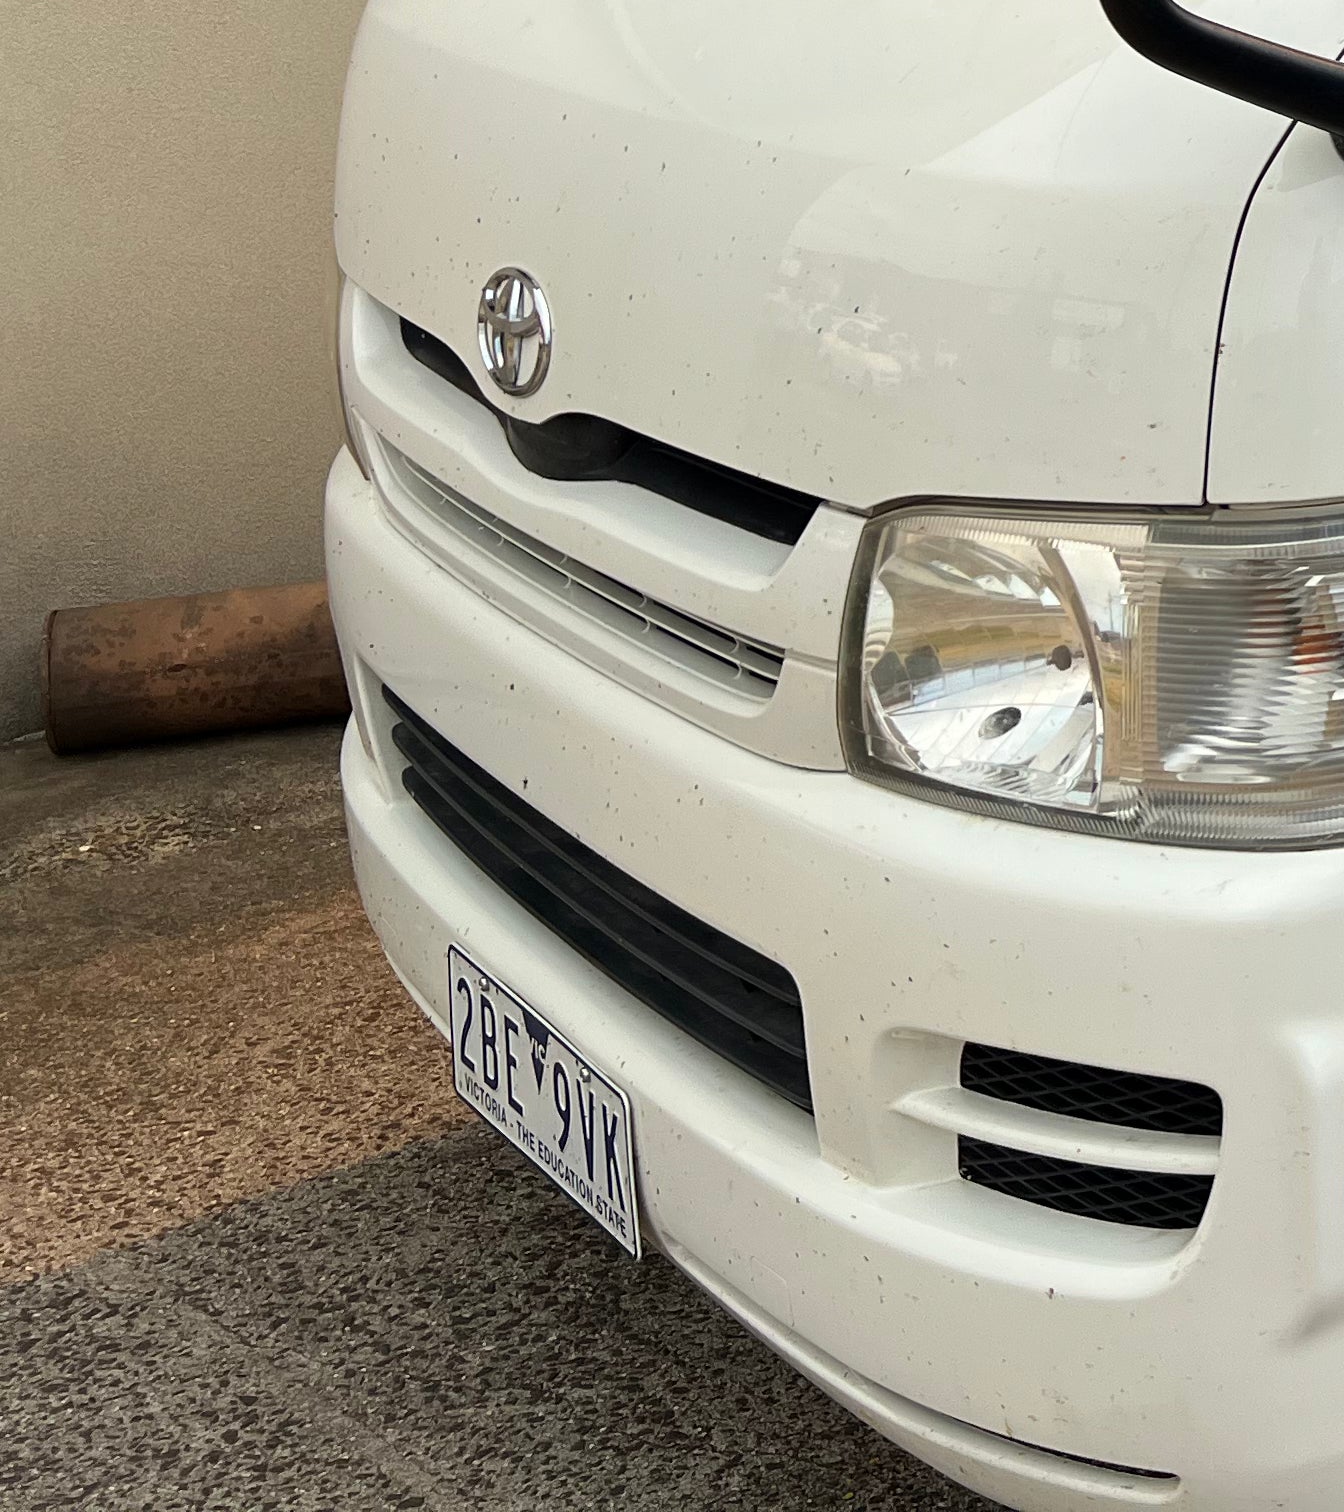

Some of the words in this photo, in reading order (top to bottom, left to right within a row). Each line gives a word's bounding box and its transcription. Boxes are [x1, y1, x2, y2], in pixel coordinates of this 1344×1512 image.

[456, 976, 524, 1117] 2BE
[553, 1061, 627, 1214] 9VK
[464, 1072, 508, 1128] VICTORIA
[516, 1119, 536, 1153] THE
[538, 1139, 594, 1207] EDUCATION
[596, 1194, 627, 1239] STATE
